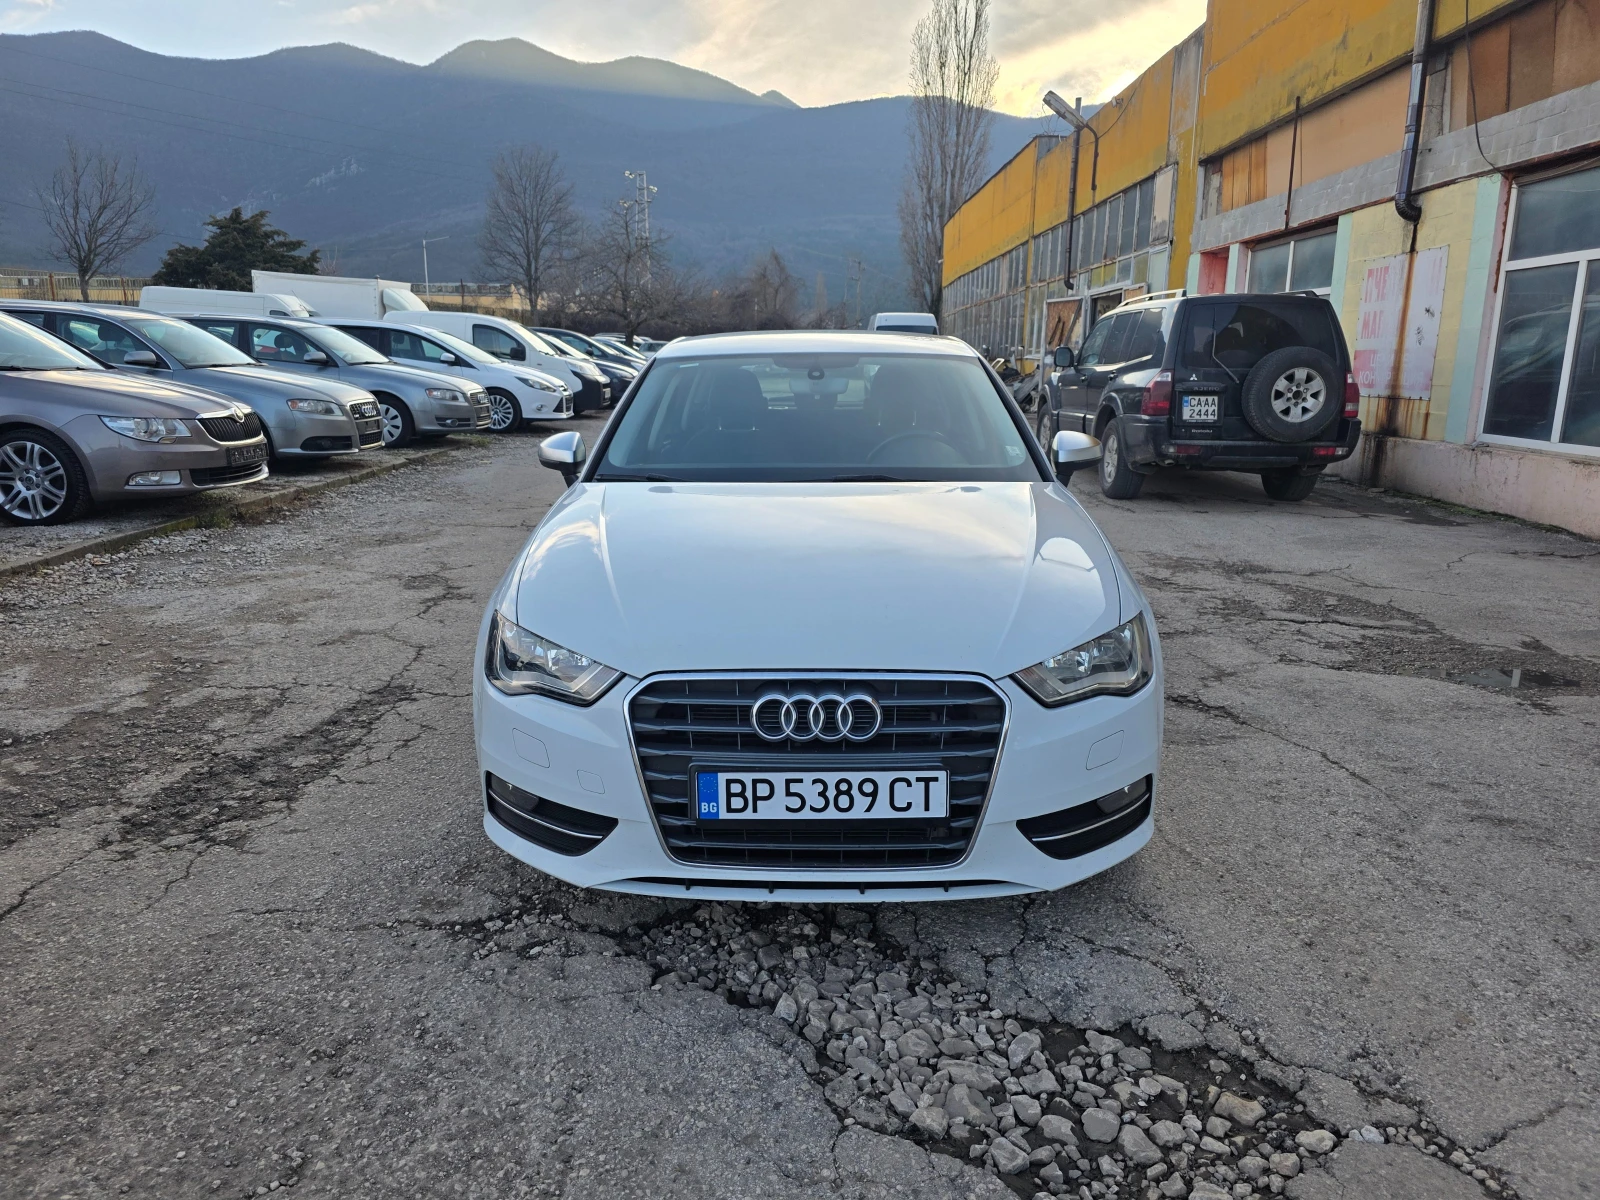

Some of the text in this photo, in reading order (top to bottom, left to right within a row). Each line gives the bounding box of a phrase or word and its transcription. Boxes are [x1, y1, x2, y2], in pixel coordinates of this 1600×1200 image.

[1189, 408, 1217, 418] 2444
[725, 776, 940, 814] BP 5389 CT
[701, 802, 718, 814] BG
